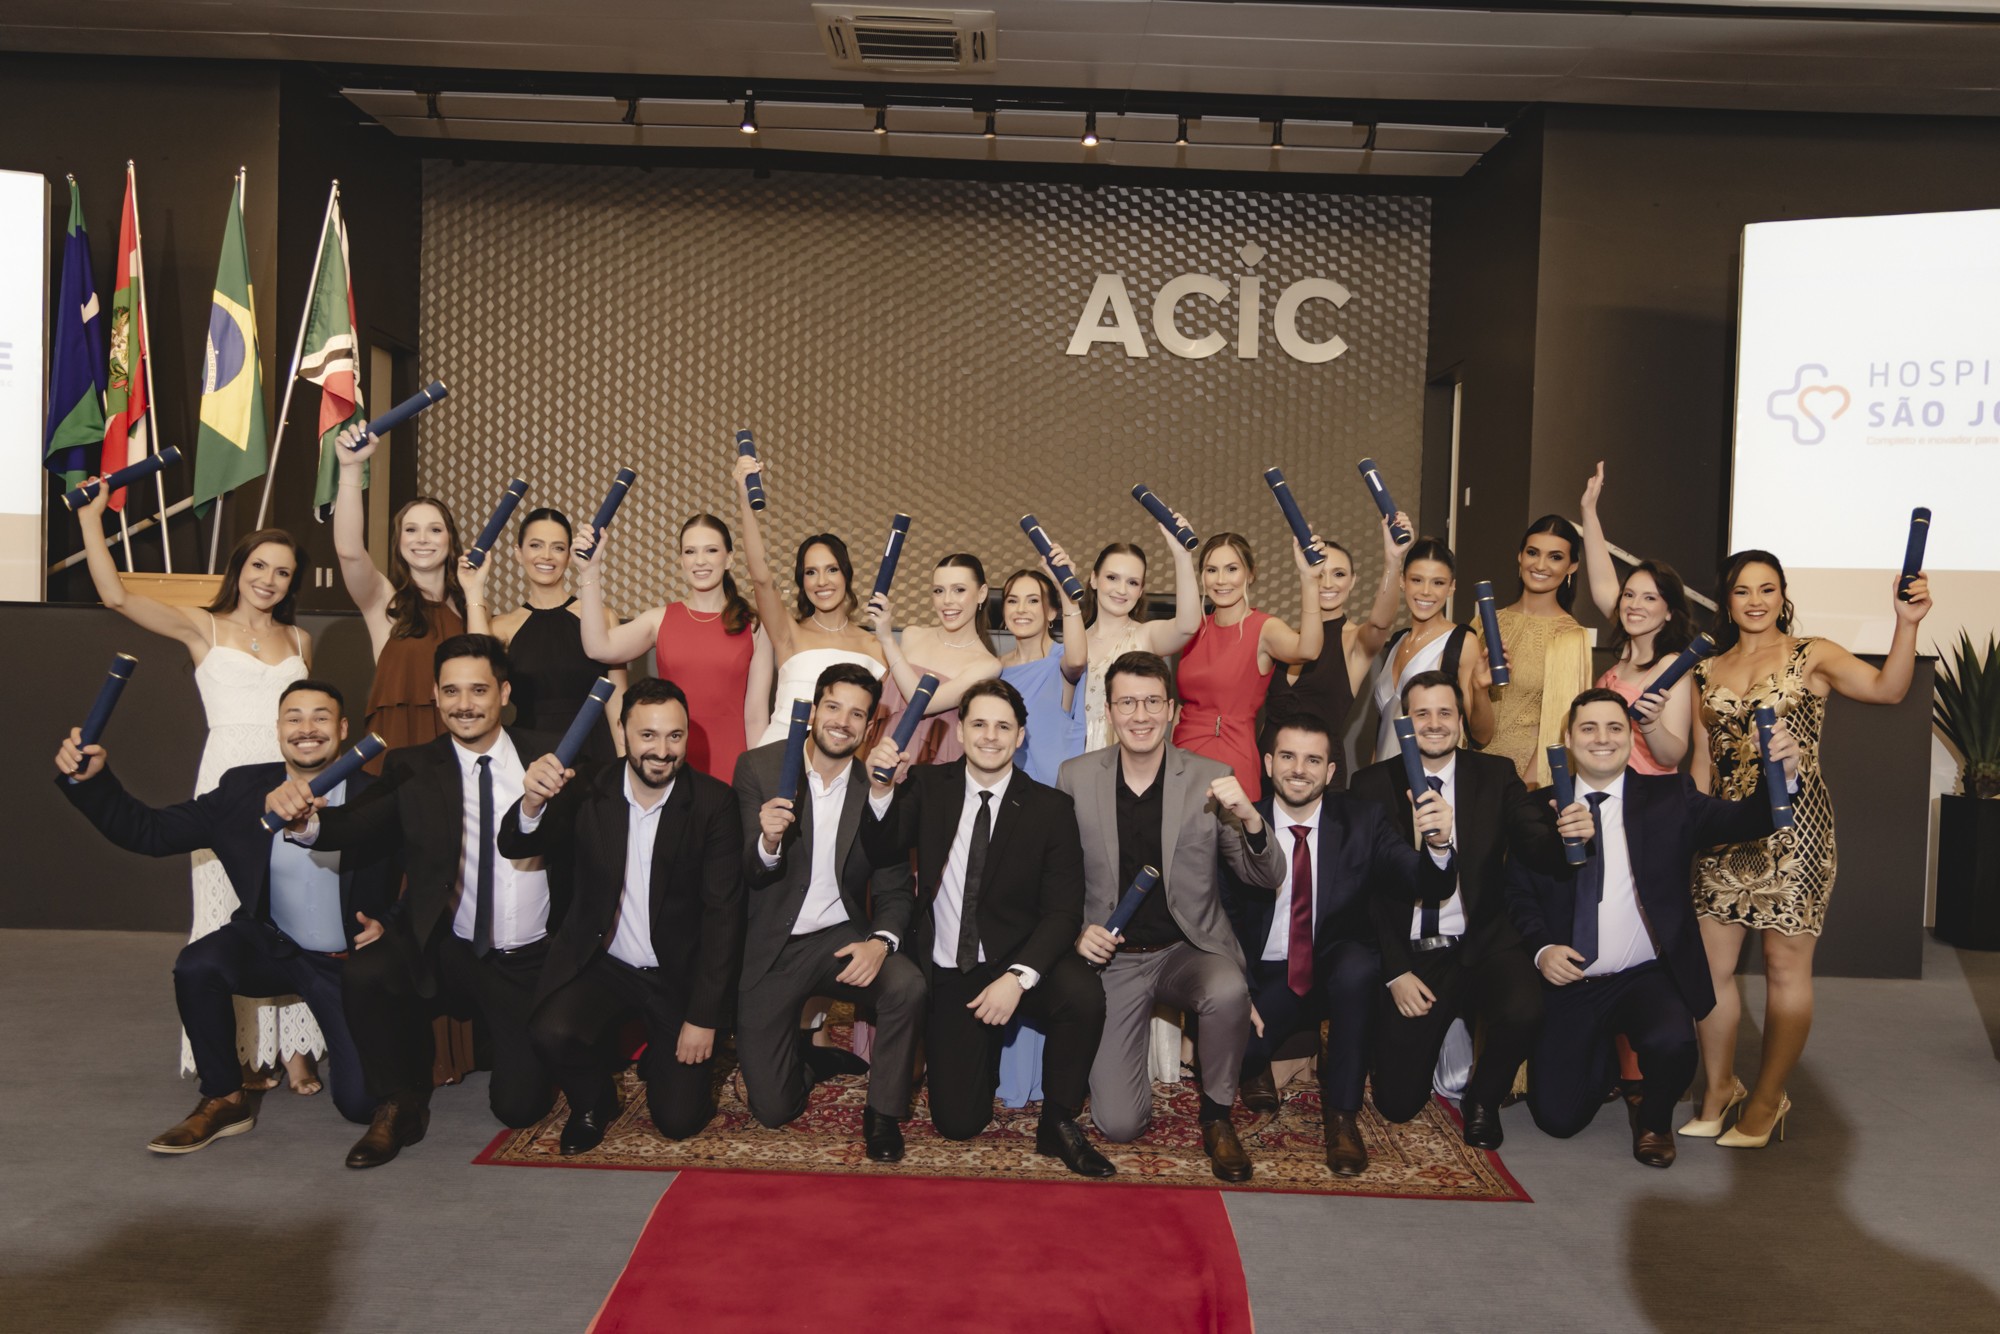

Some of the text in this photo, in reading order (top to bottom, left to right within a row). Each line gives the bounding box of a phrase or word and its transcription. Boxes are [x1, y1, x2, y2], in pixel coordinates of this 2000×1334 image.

[1869, 359, 2000, 388] HOSPI
[1868, 396, 1945, 427] SÃO
[1866, 435, 1999, 446] Completo e inovador para
